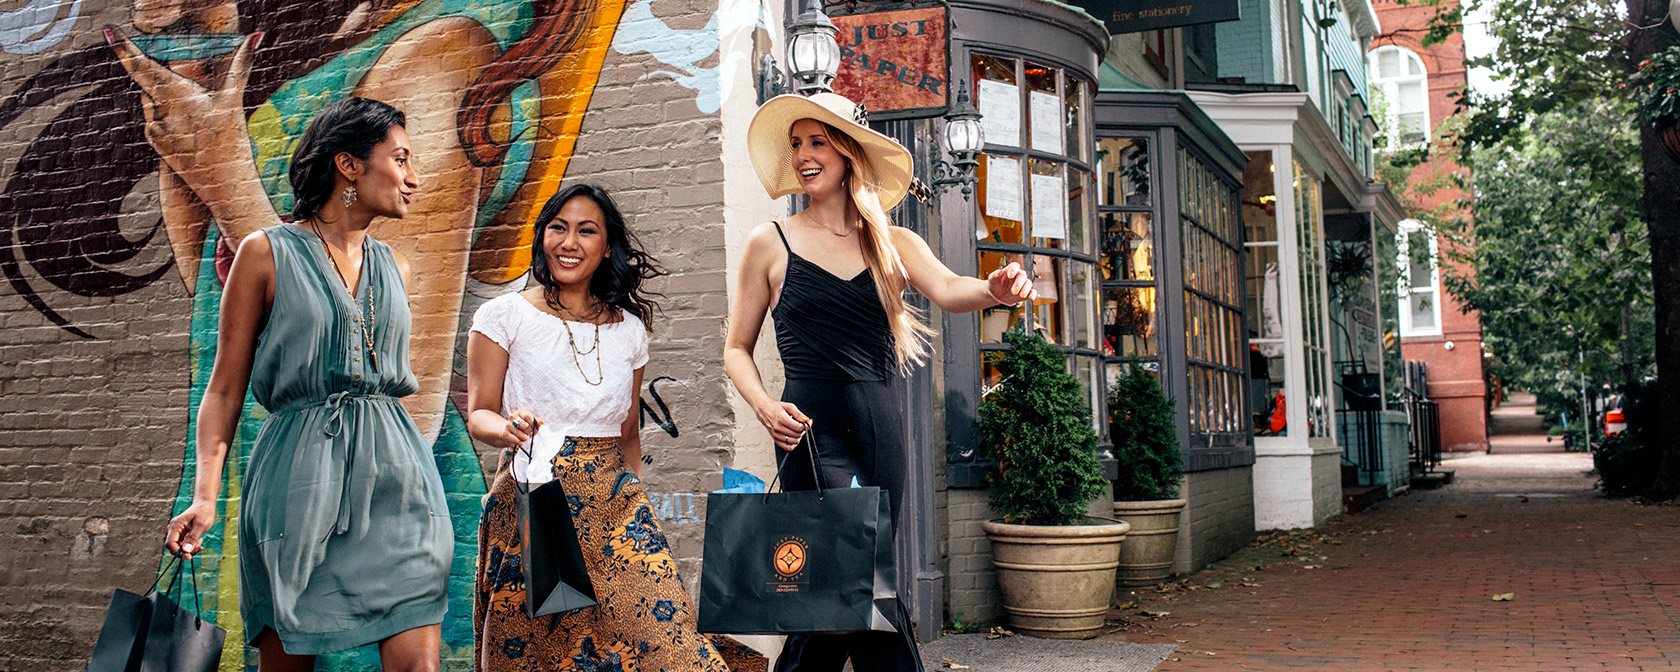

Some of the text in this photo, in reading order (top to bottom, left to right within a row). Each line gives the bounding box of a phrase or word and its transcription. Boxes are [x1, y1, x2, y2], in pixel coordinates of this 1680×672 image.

[1112, 5, 1192, 21] fine stationery
[848, 19, 933, 47] JUST
[839, 45, 942, 96] PAPER
